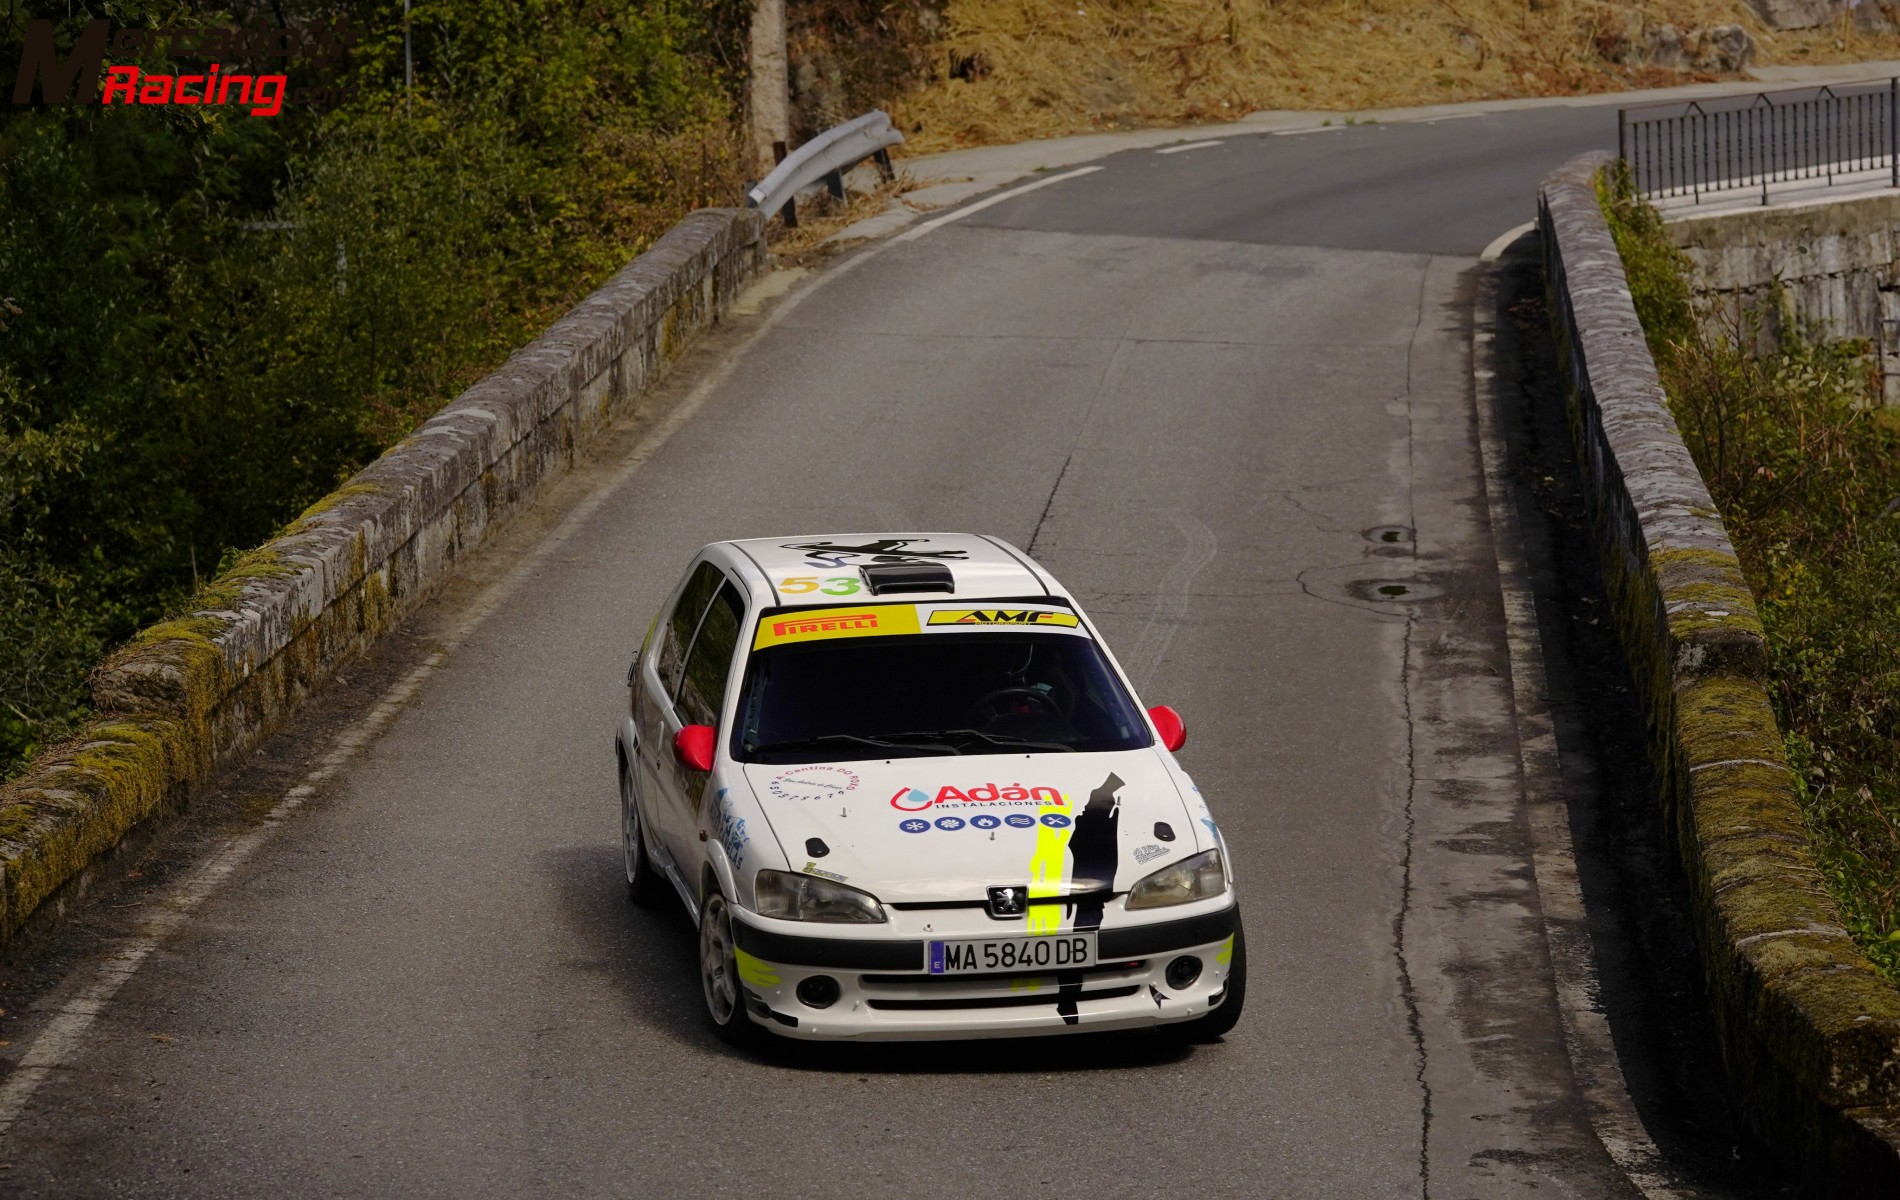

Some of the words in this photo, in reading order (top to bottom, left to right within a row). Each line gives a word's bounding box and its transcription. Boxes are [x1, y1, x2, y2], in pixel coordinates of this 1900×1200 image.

[778, 576, 861, 596] 53
[773, 614, 878, 636] PIRELLI
[956, 610, 1054, 623] AMF
[934, 782, 1065, 806] Adán
[936, 801, 1052, 809] INSTALACIONES
[945, 944, 978, 971] MA
[984, 940, 1051, 968] 5840
[1056, 938, 1088, 965] DB
[934, 961, 941, 969] E
